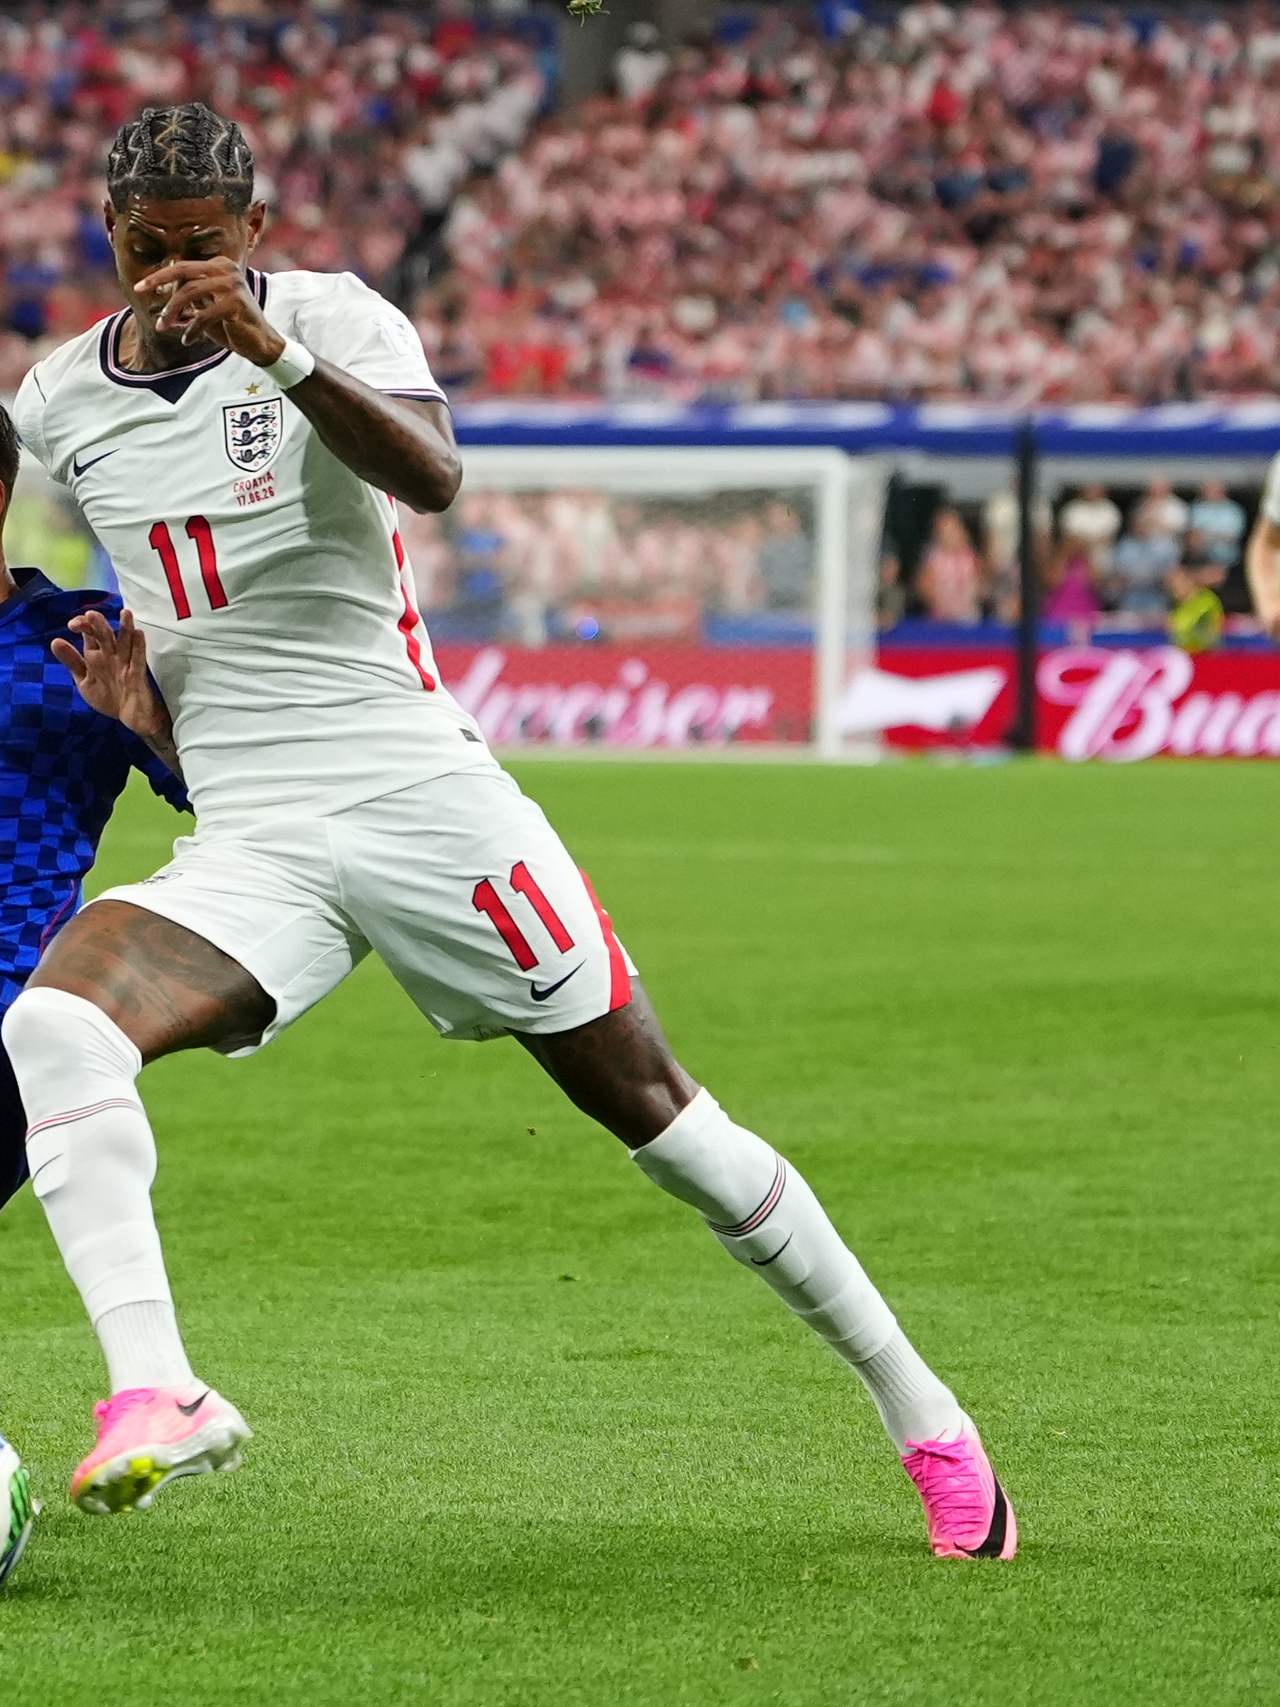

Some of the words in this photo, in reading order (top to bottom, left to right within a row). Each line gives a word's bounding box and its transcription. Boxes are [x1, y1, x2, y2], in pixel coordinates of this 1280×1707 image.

[233, 471, 274, 493] CROATIA
[236, 486, 275, 507] 17.06.26
[149, 515, 228, 621] 11
[471, 860, 575, 972] 11
